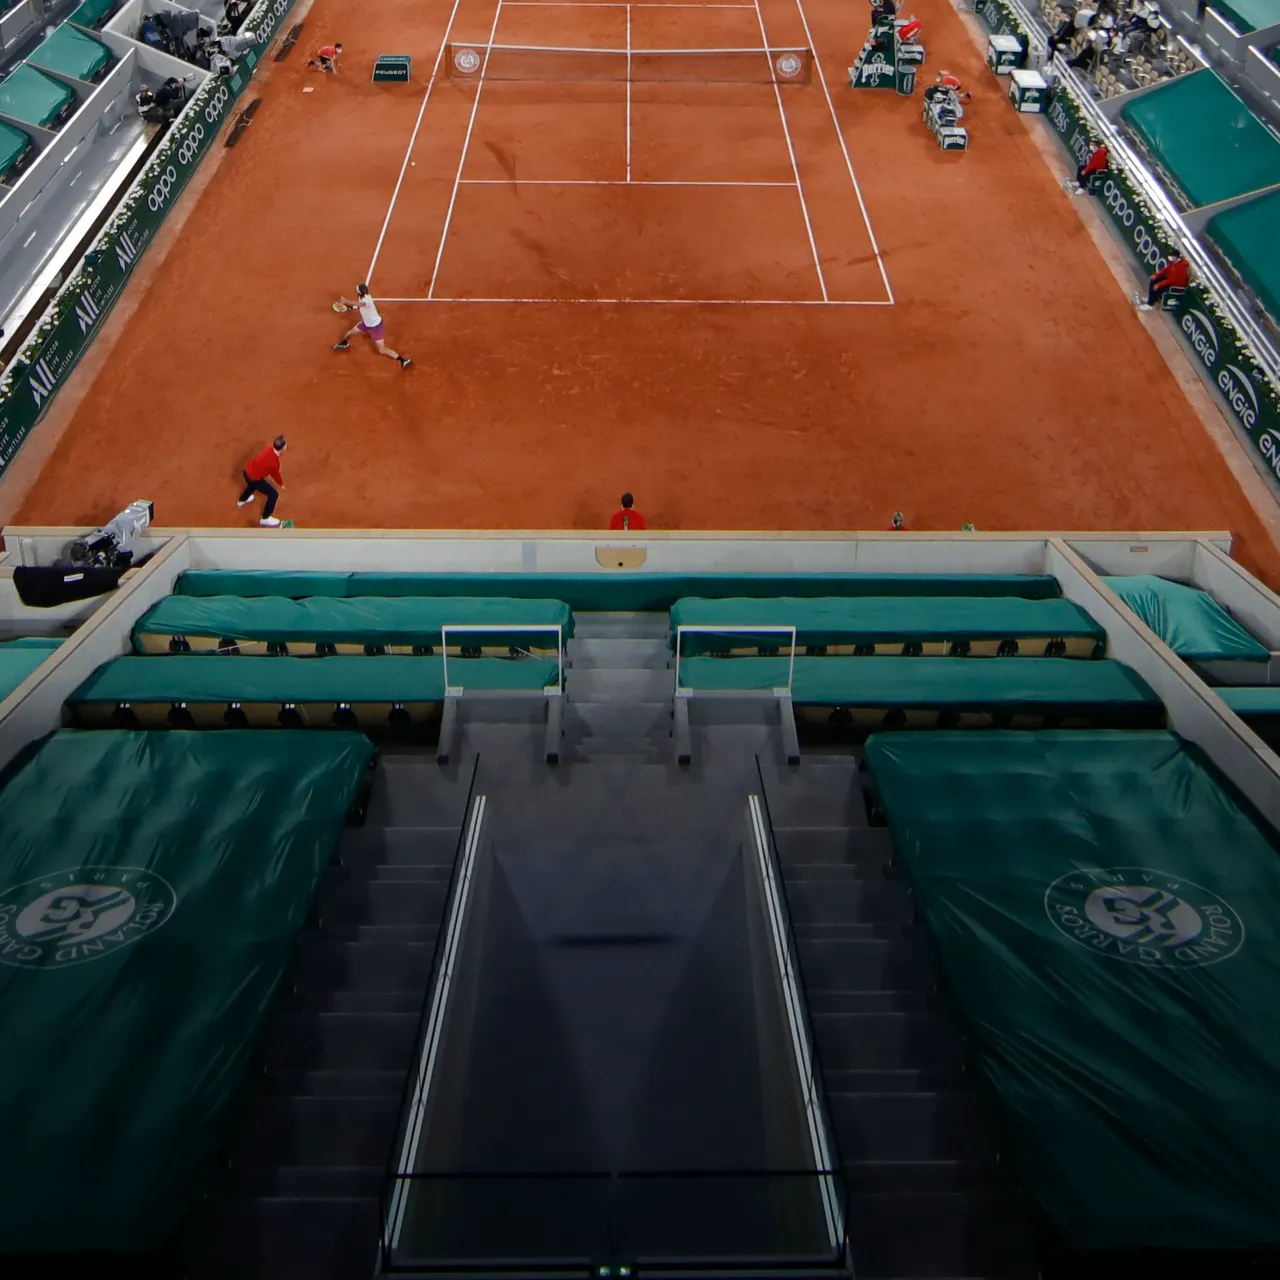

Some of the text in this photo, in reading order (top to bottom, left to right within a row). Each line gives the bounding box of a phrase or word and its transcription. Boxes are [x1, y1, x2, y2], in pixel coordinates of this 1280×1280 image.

[257, 12, 275, 44] oppo
[205, 86, 229, 124] oppo
[178, 123, 204, 165] oppo
[147, 165, 177, 212] oppo
[1103, 179, 1135, 227] oppo
[54, 350, 74, 379] LIMITLESS
[3, 425, 27, 462] LIMITLESS
[55, 900, 165, 962] ROLAND
[1055, 903, 1234, 962] ROLAND GARROS
